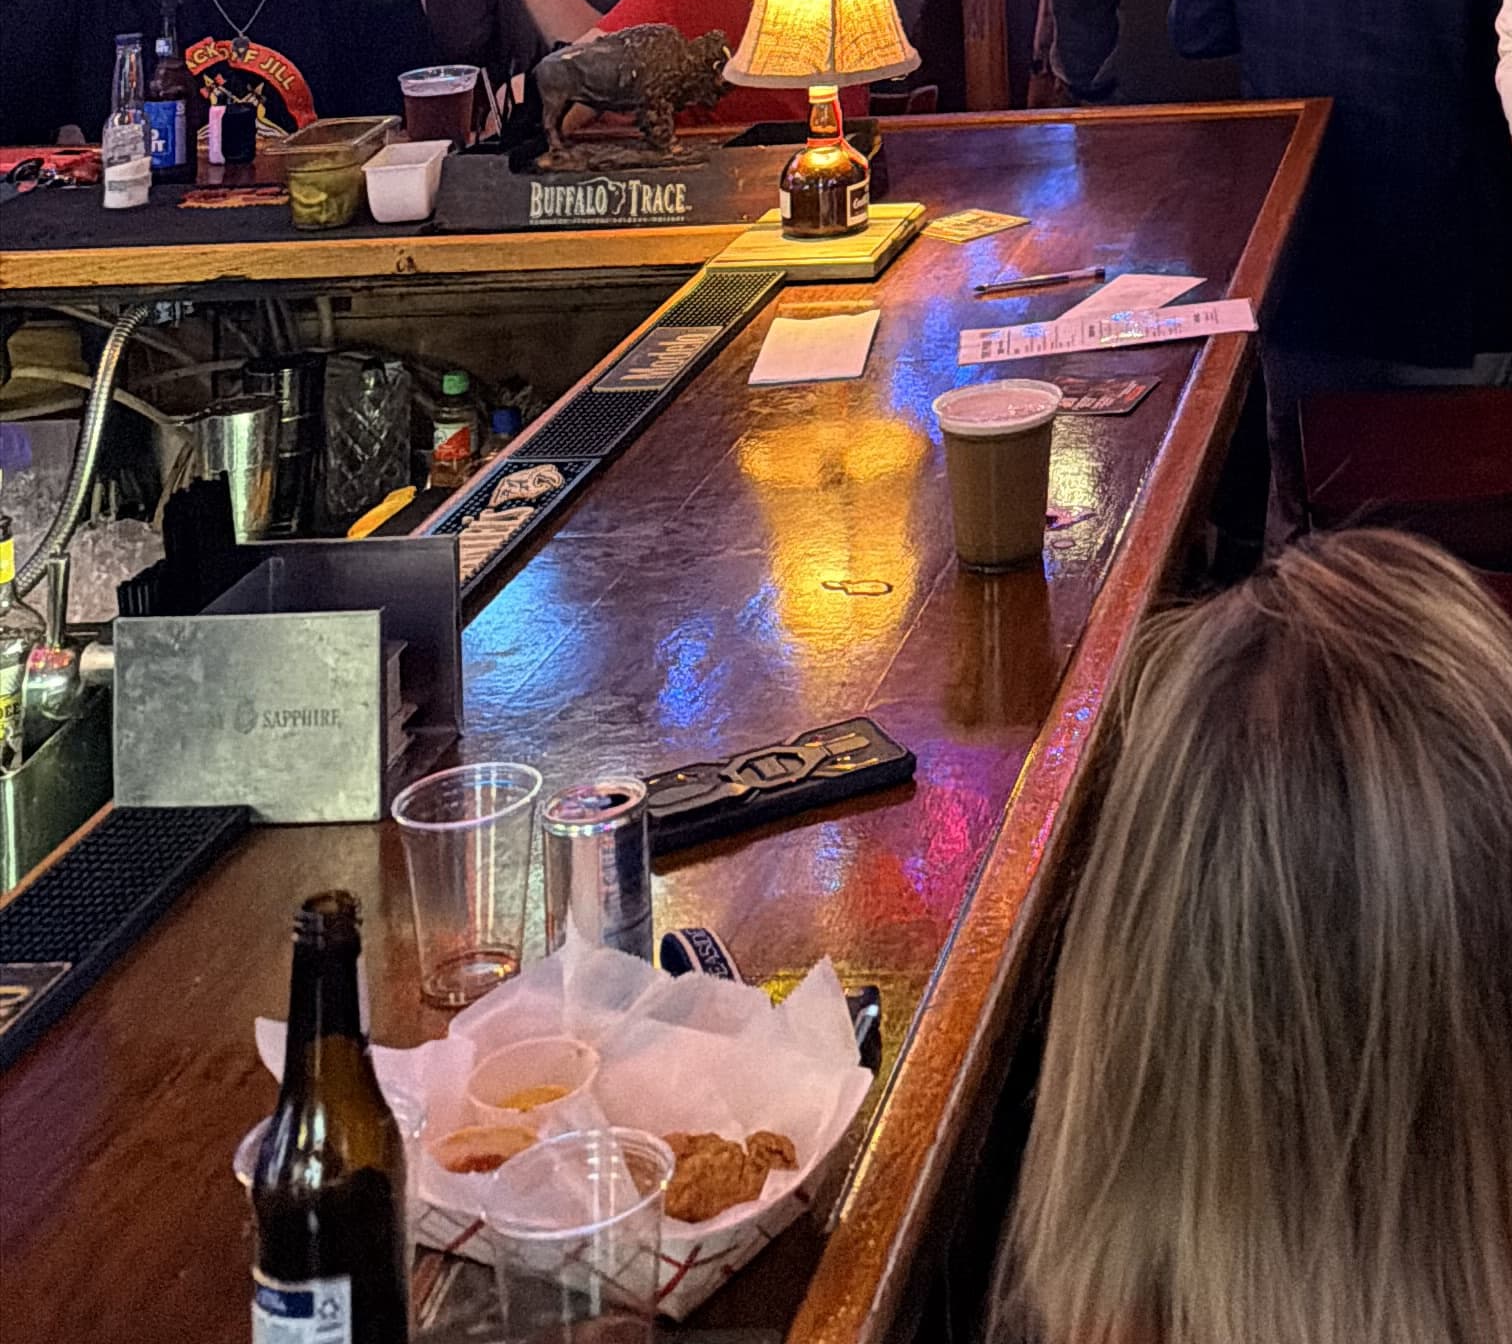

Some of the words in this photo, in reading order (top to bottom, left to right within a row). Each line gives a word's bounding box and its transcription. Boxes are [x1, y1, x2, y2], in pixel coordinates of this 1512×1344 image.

[259, 53, 295, 93] JILL
[529, 180, 608, 218] BUFFALO
[628, 178, 686, 216] TRACE
[624, 330, 714, 385] Modelo
[262, 708, 343, 730] SAPPHIRE
